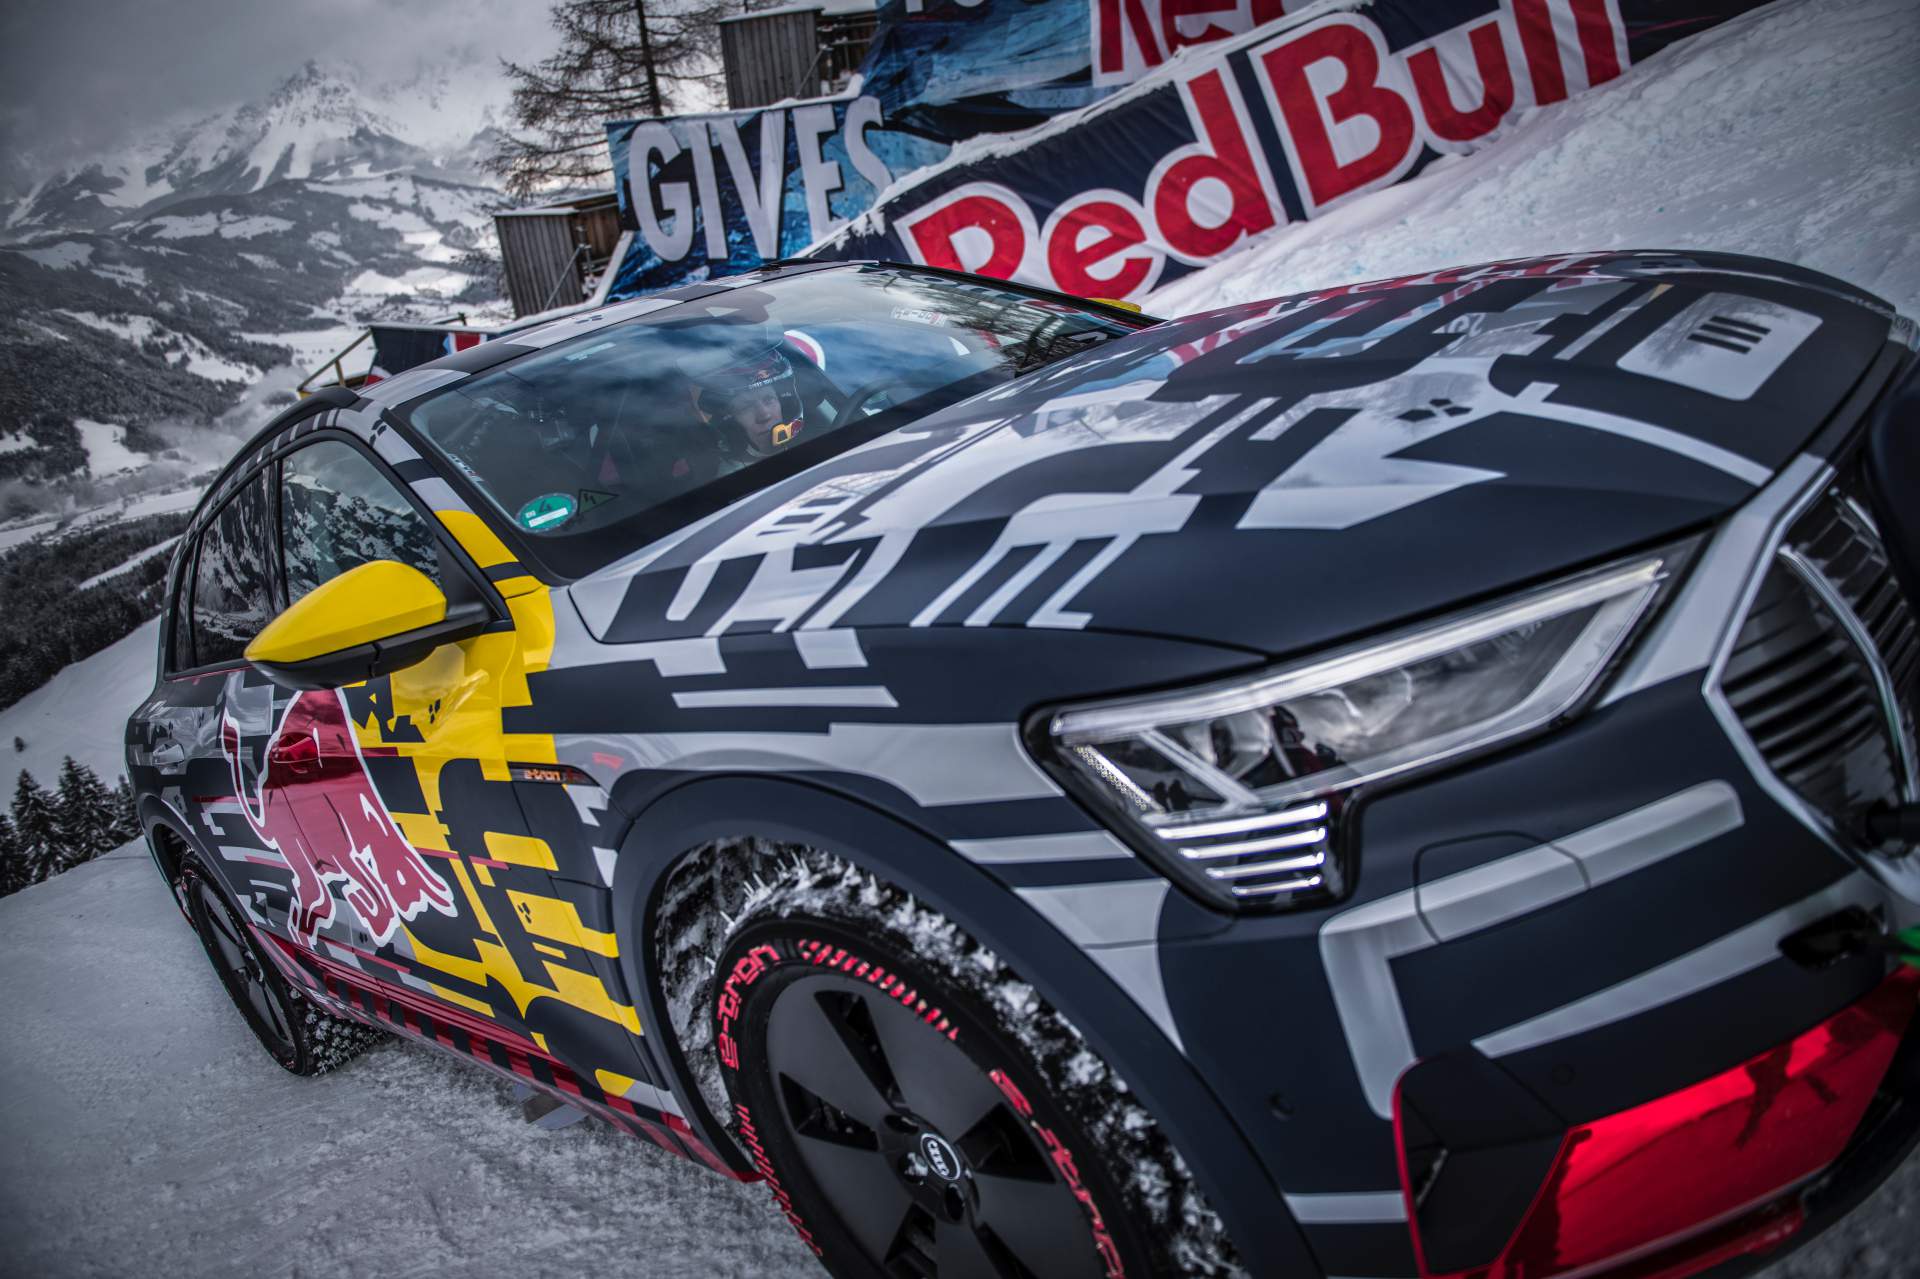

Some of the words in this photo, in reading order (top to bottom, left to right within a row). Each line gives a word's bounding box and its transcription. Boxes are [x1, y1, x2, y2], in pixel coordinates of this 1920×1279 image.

[628, 97, 894, 262] GIVES
[1259, 0, 1622, 208] Bull
[523, 769, 561, 781] e-tron
[716, 943, 782, 1073] e-tron
[988, 1068, 1125, 1279] e-tro
